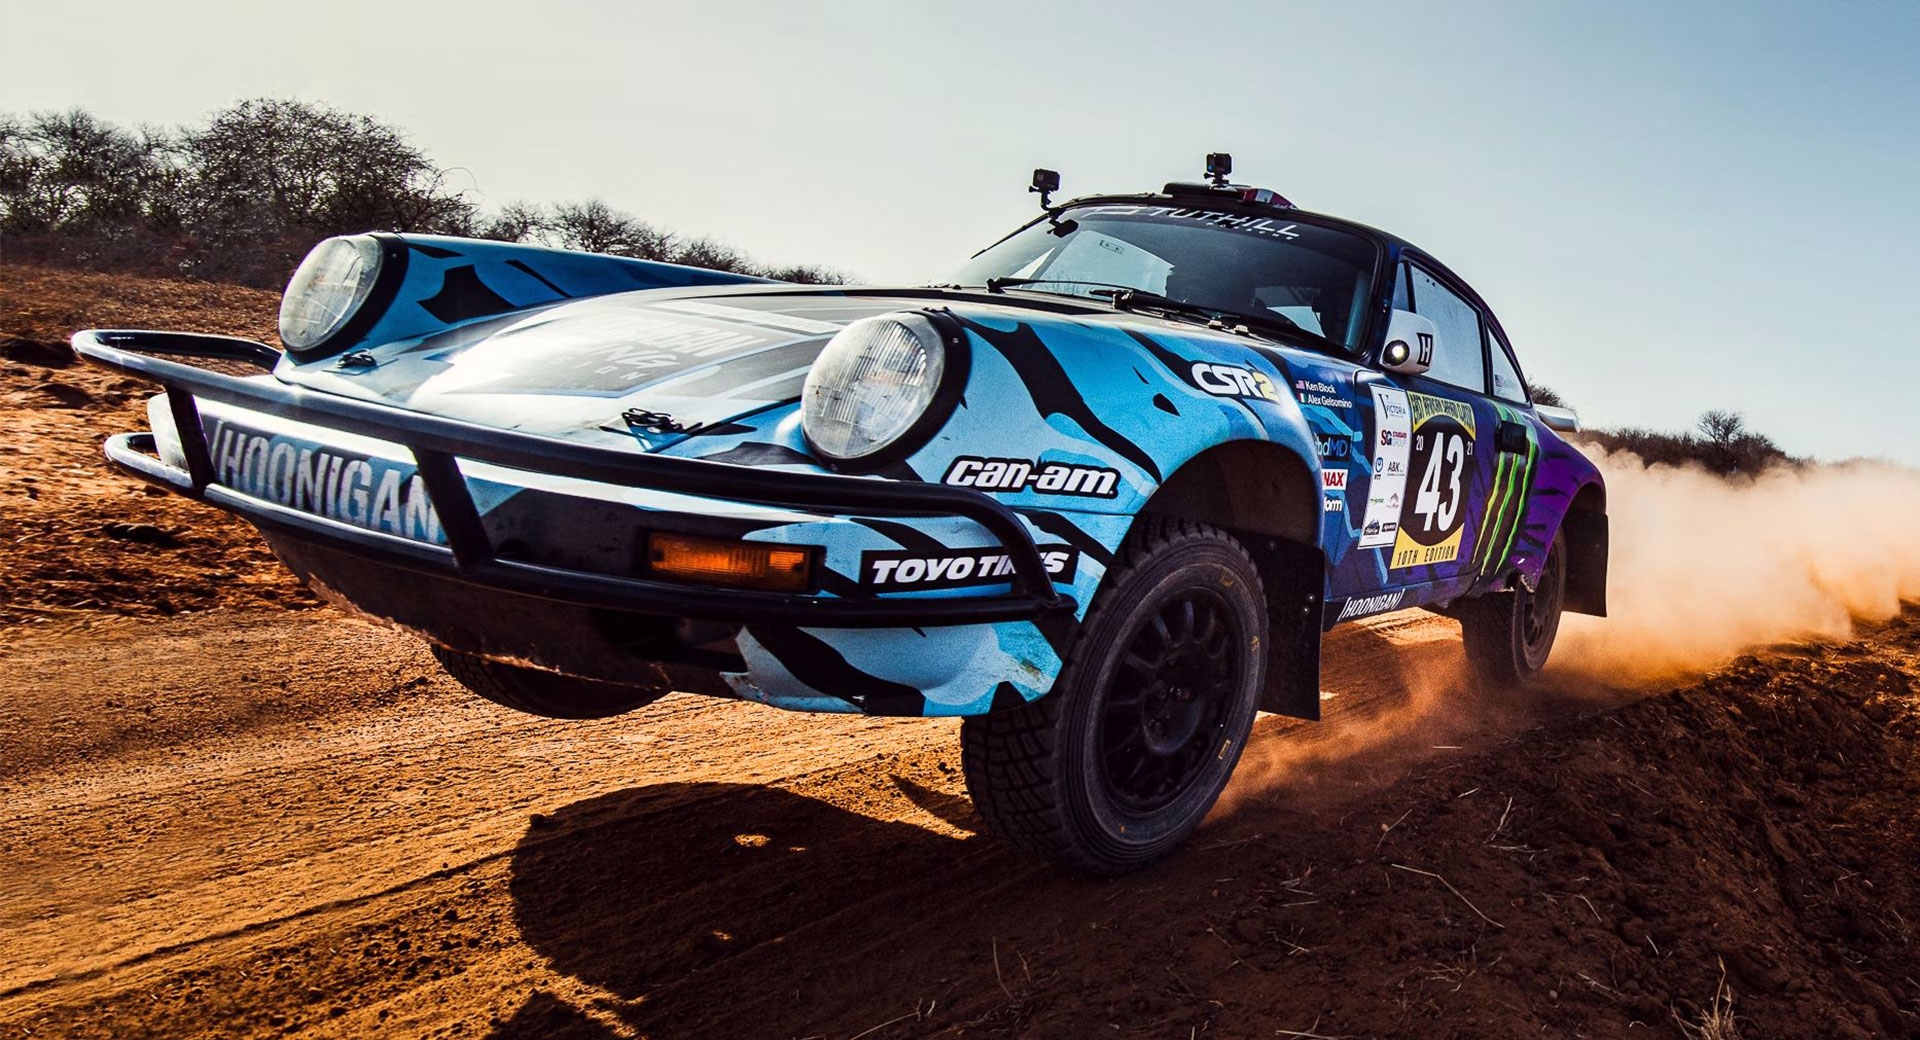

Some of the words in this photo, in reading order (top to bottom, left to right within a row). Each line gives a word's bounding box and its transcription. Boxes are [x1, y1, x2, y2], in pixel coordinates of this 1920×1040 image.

[1149, 206, 1300, 238] TUTHILL
[1191, 362, 1280, 402] CSR2
[1305, 380, 1318, 391] Ken
[1317, 382, 1337, 394] Block
[1307, 393, 1321, 405] Alex
[1321, 395, 1353, 408] Gelsomino
[1415, 434, 1424, 451] 20
[1466, 440, 1474, 456] 21
[1415, 432, 1464, 532] 43
[872, 556, 976, 584] TOYO
[977, 551, 1070, 578] TIS
